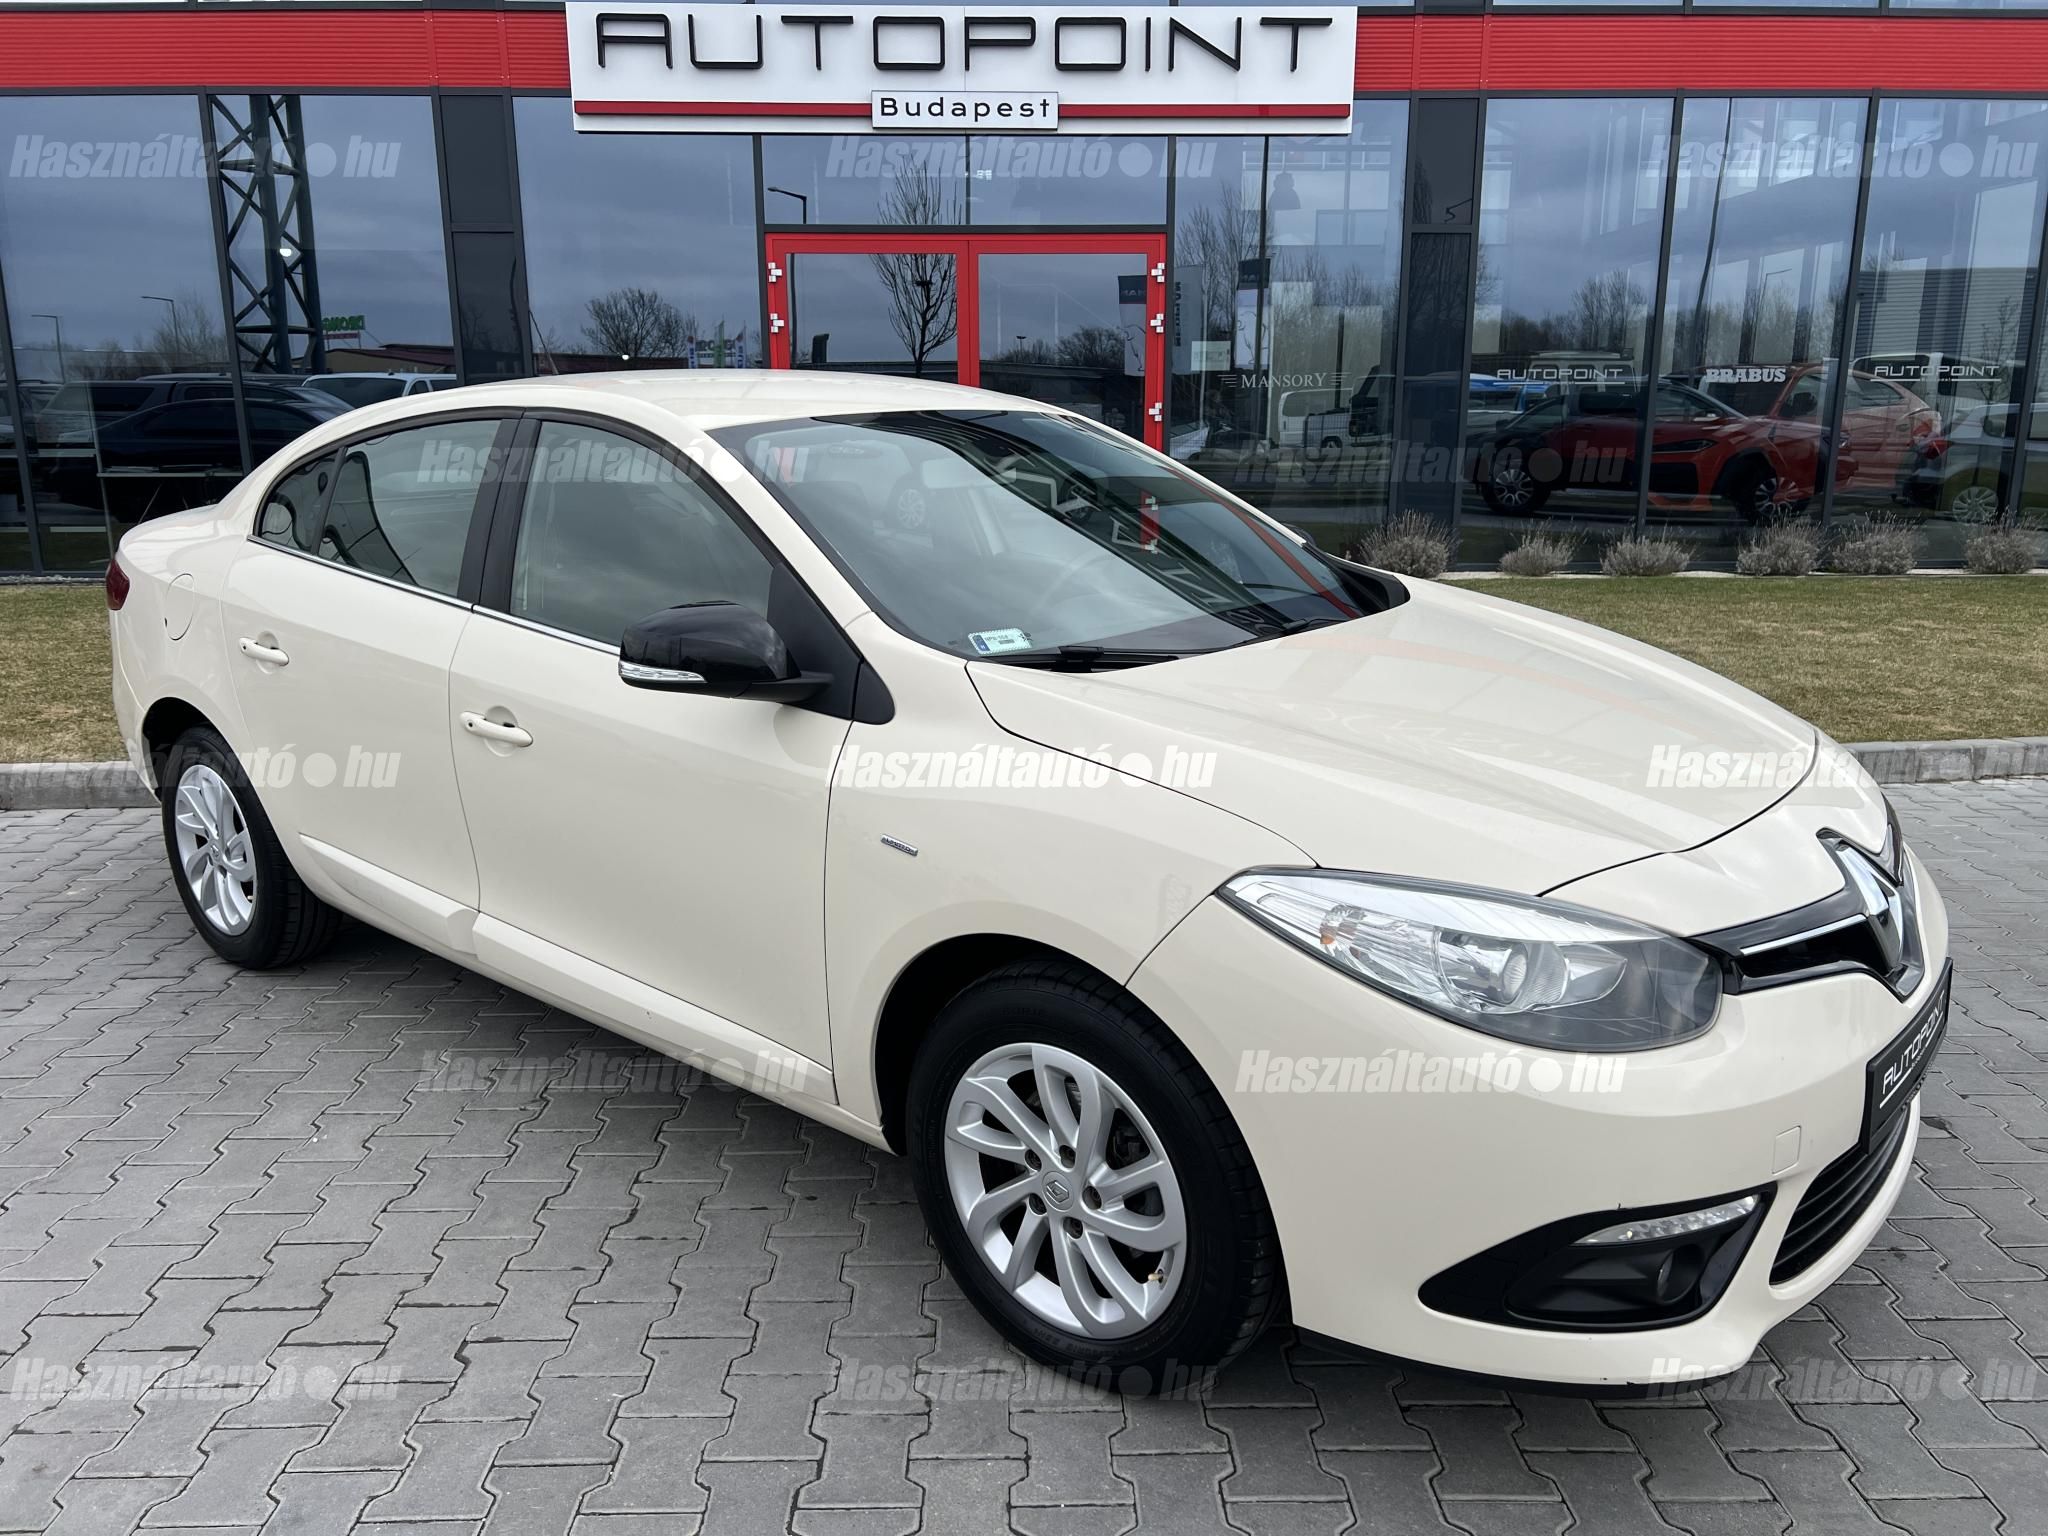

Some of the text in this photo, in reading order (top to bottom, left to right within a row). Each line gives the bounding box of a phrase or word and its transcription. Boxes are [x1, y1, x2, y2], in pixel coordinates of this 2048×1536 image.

[596, 13, 1333, 72] AUTOPOINT
[880, 96, 1050, 123] Budapest
[1496, 368, 1623, 380] AUTOPOINT
[1705, 368, 1787, 383] BRABUS
[1874, 365, 2000, 377] AUTOPOINT
[1241, 372, 1328, 388] MANSORY
[1882, 990, 1945, 1095] AUTOPOINT
